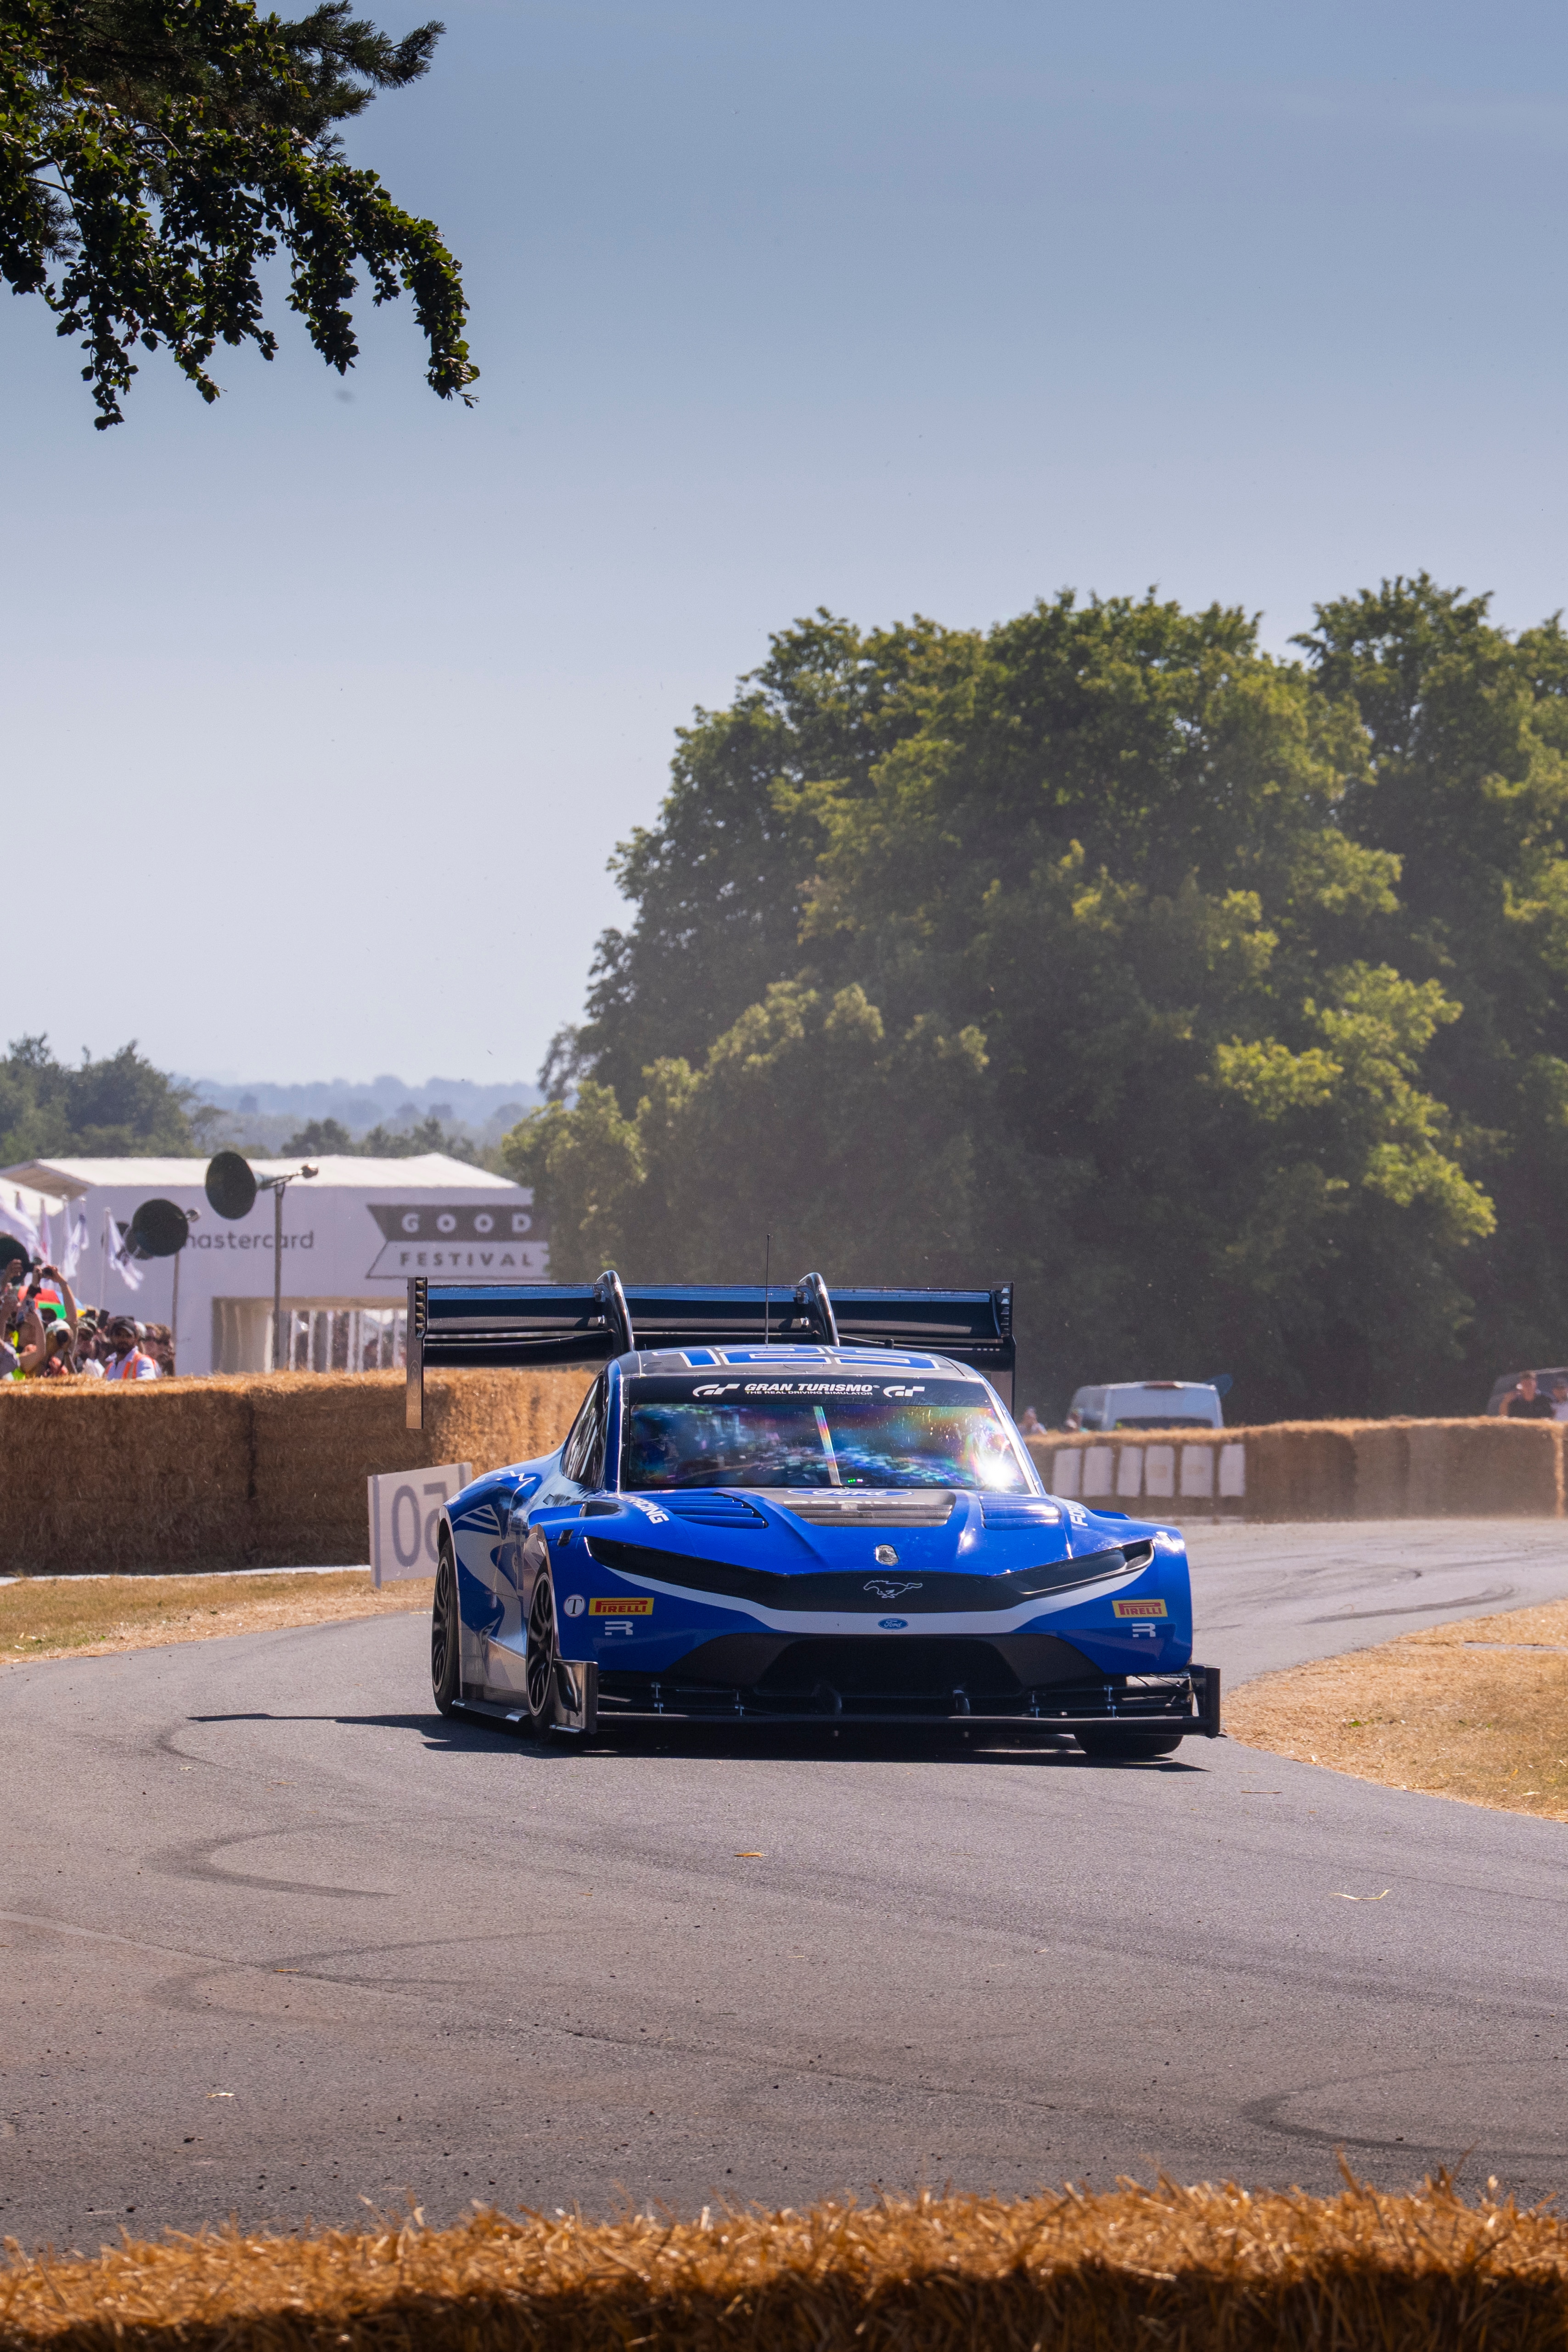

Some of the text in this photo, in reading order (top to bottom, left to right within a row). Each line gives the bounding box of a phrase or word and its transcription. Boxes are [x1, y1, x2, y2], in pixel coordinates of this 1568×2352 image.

[401, 1212, 532, 1234] GOOD
[399, 1251, 533, 1266] FESTIVAL
[652, 1345, 940, 1371] 125
[567, 1598, 583, 1615] T
[595, 1600, 648, 1613] PIRELLI
[1118, 1602, 1163, 1615] PIRELLI
[883, 1619, 903, 1627] Ford
